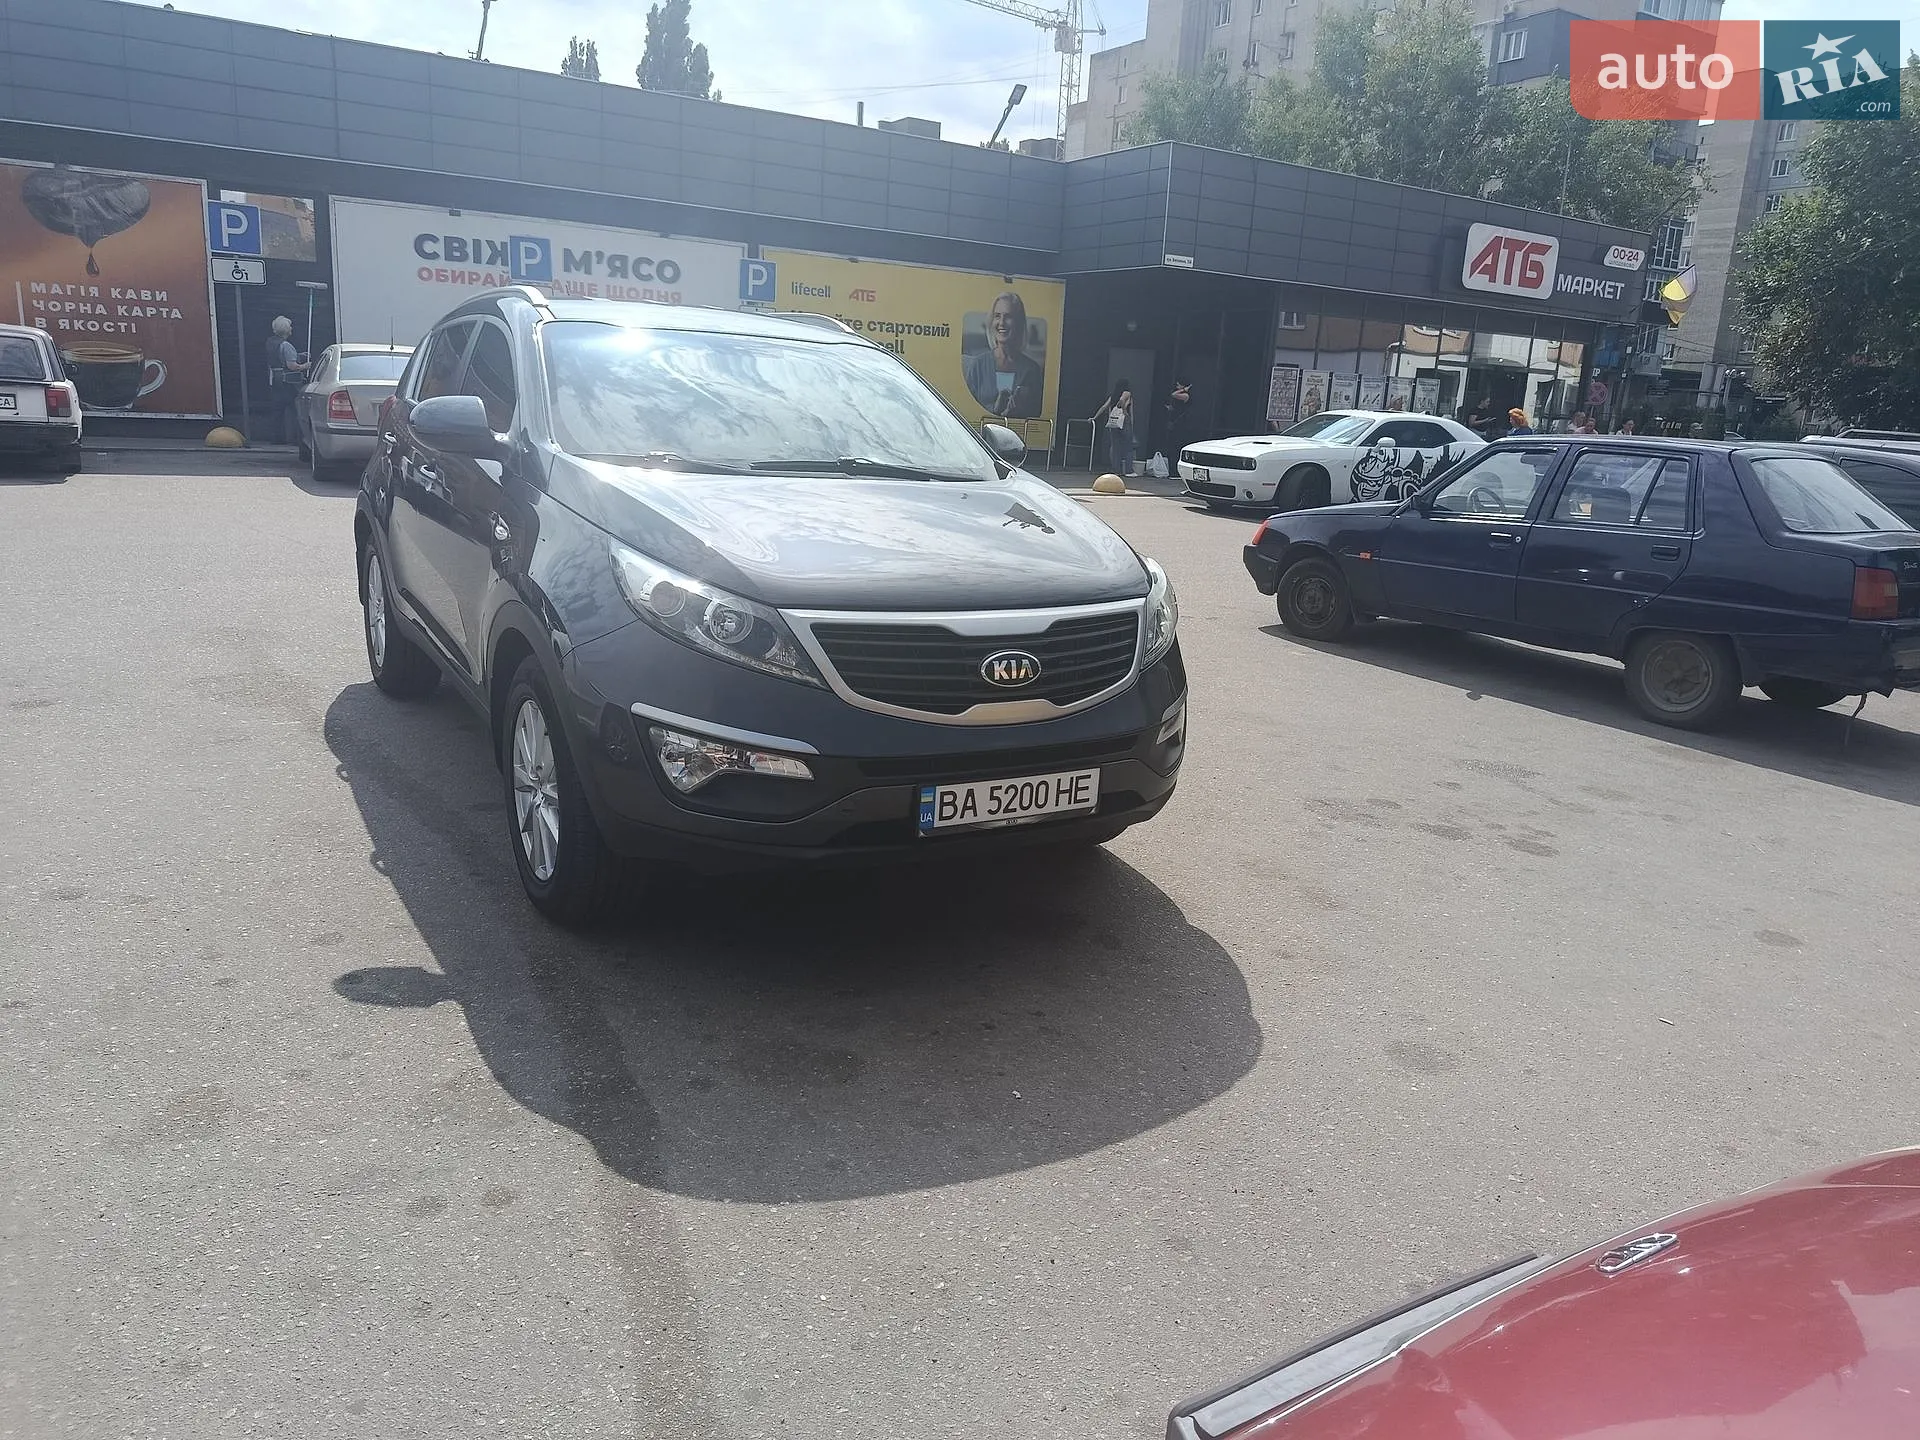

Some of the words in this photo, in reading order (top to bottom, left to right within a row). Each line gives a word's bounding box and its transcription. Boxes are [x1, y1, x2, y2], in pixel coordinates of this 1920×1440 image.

[221, 207, 247, 248] P
[414, 233, 510, 267] СВІЖ
[563, 247, 681, 284] М'ЯСО
[519, 241, 543, 276] P
[1469, 235, 1552, 290] АТБ
[1613, 248, 1639, 262] 00-24
[552, 279, 599, 297] АЩЕ
[748, 263, 767, 296] P
[1556, 273, 1625, 300] МАРКЕТ
[30, 282, 99, 297] МАГІЯ
[110, 287, 168, 302] КАВИ
[791, 281, 831, 299] lifecell
[849, 288, 877, 302] АТБ
[32, 299, 108, 315] ЧОРНА
[117, 305, 183, 319] КАРТА
[34, 317, 47, 328] В
[58, 318, 137, 334] ЯКОСТІ
[867, 319, 950, 338] стартовий
[992, 659, 1034, 681] KIA
[938, 788, 978, 821] BA
[987, 780, 1050, 816] 5200
[1055, 774, 1092, 807] HE
[920, 813, 934, 823] UA
